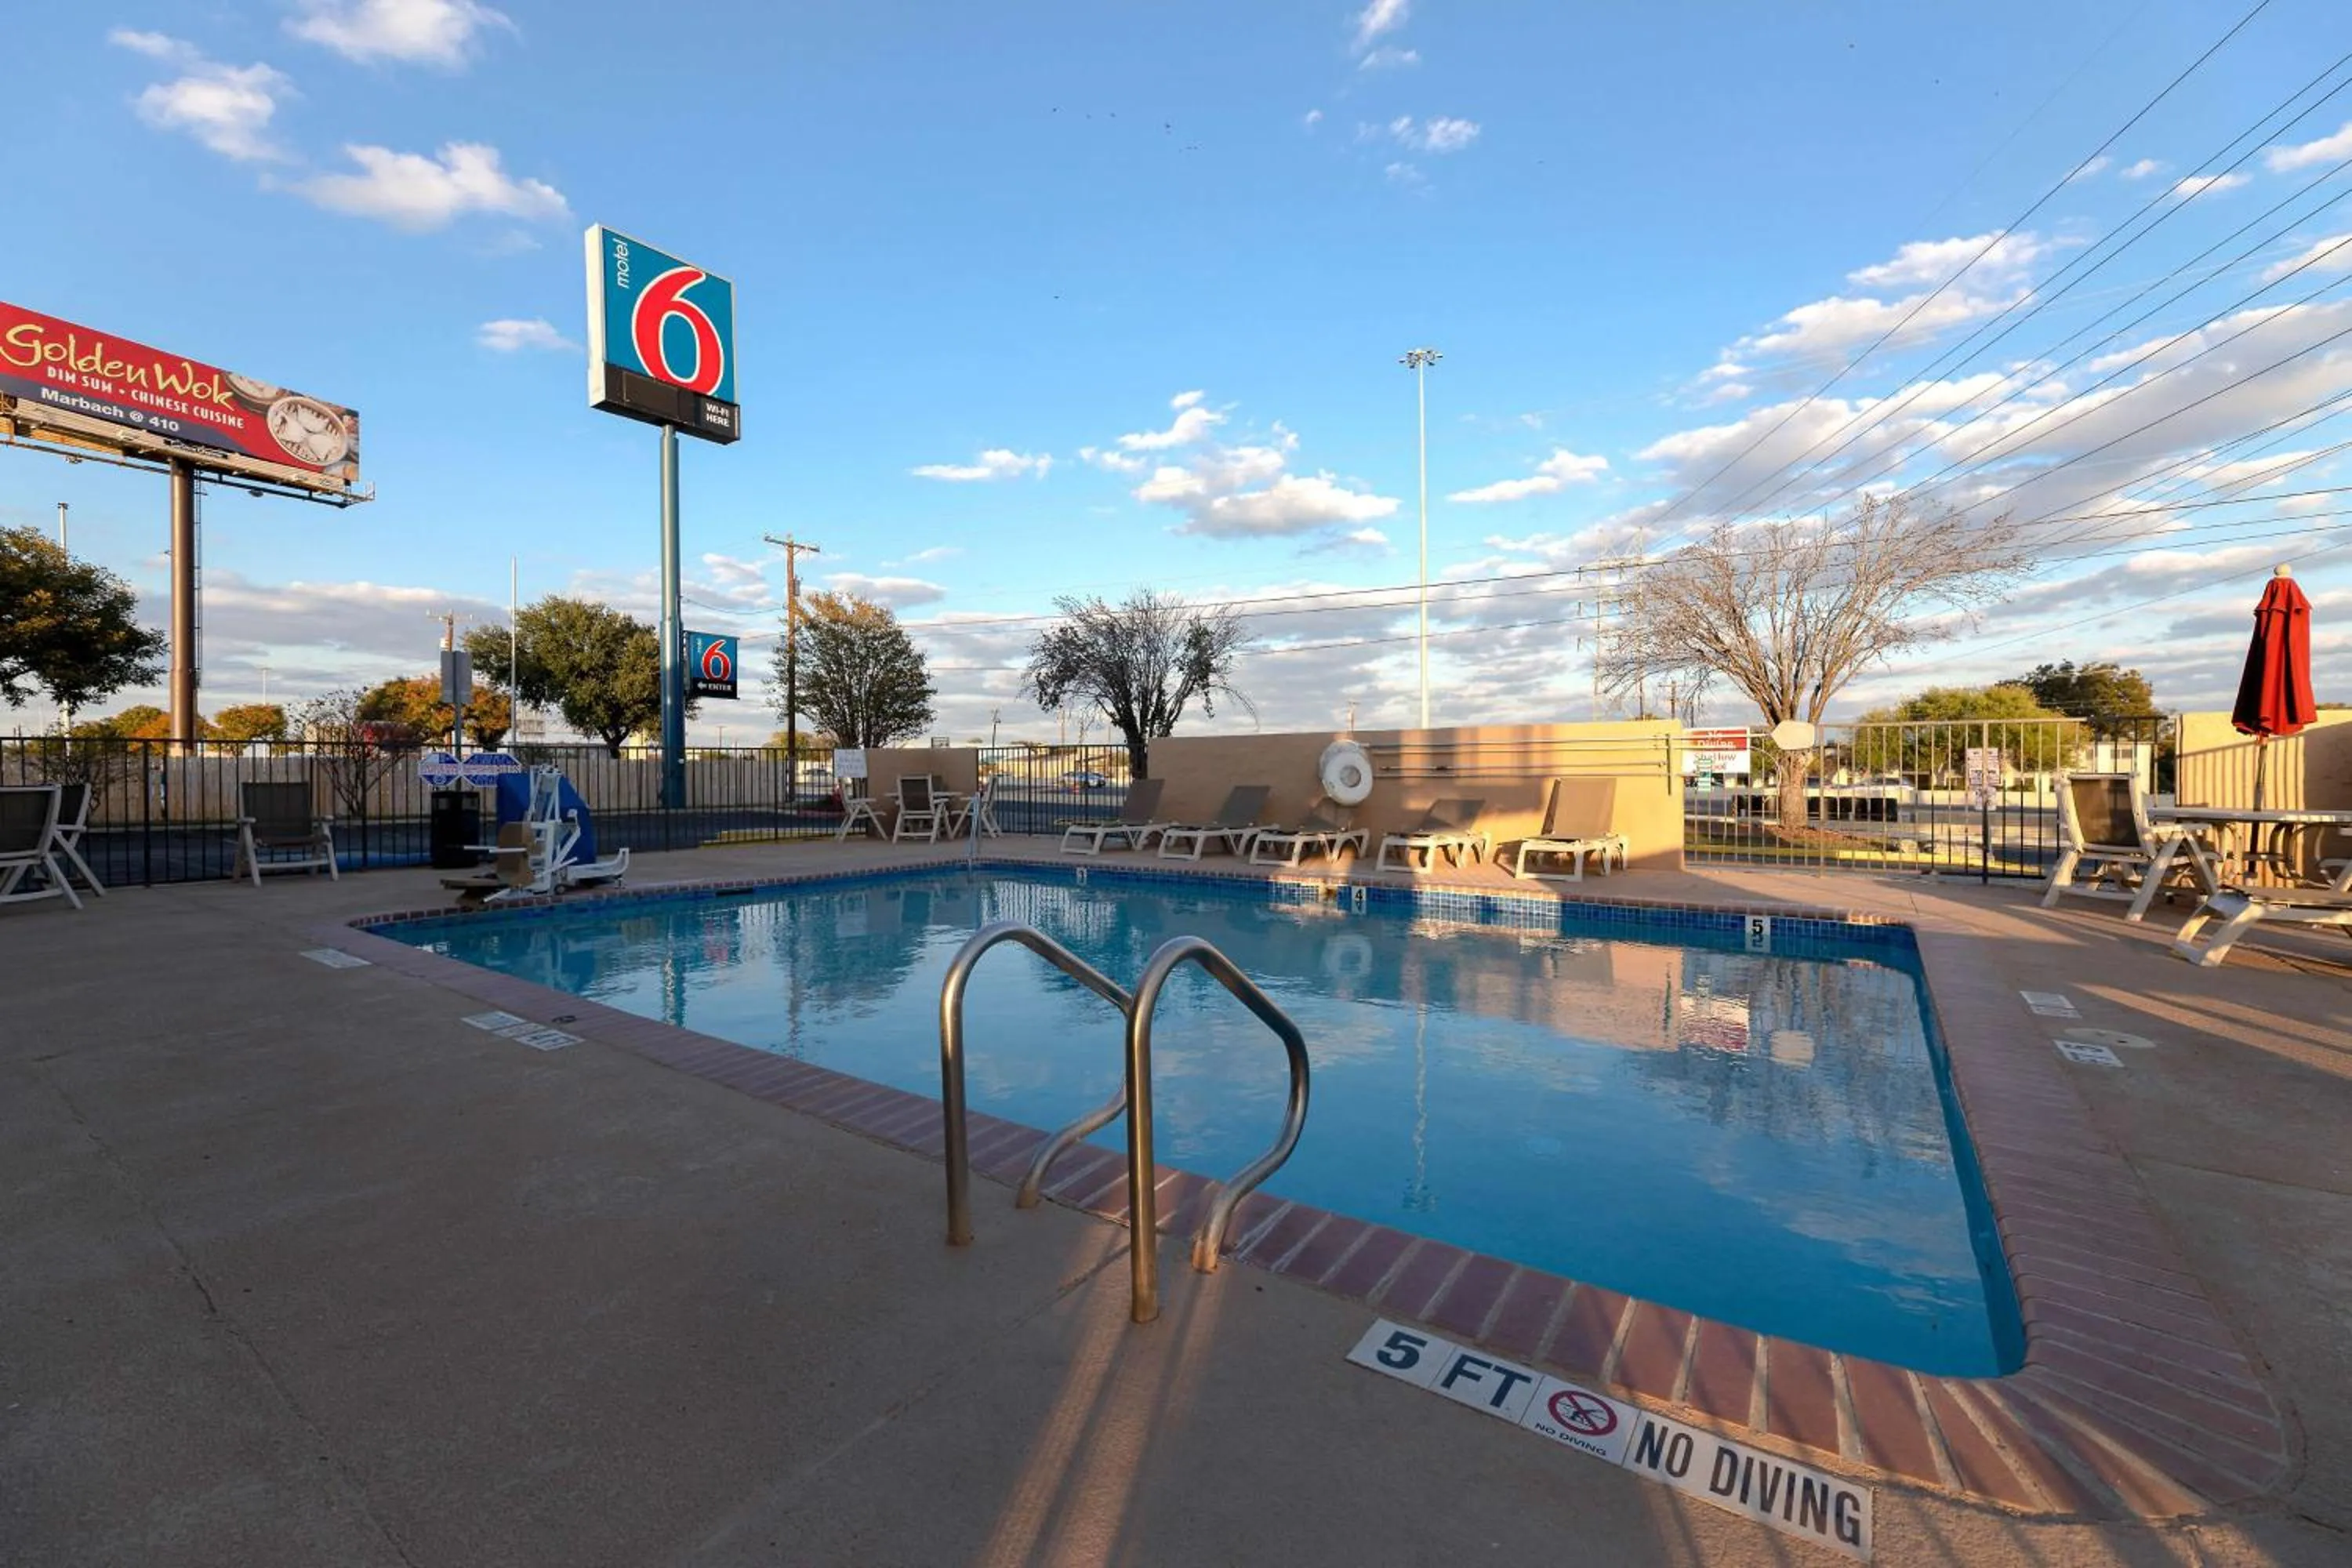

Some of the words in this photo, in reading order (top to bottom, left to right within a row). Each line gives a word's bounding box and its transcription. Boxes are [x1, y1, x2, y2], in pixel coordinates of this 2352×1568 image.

[612, 238, 630, 289] motel
[631, 266, 724, 396] 6
[0, 324, 148, 389] Golden
[153, 361, 235, 412] Wok
[41, 387, 125, 419] Marbach
[129, 410, 143, 423] @
[148, 416, 180, 432] 410
[47, 365, 76, 383] DIM
[82, 376, 113, 394] SUM
[131, 390, 189, 415] CHINESE
[193, 405, 245, 429] CUISINE
[706, 413, 730, 427] HERE
[701, 639, 731, 681] 6
[1354, 888, 1363, 901] 4
[1752, 918, 1763, 935] 5
[1375, 1330, 1428, 1370] 5
[1439, 1354, 1531, 1409] FT
[1534, 1421, 1556, 1435] NO
[1559, 1432, 1606, 1456] DIVING
[1634, 1420, 1694, 1478] NO
[1708, 1445, 1861, 1547] DIVING
